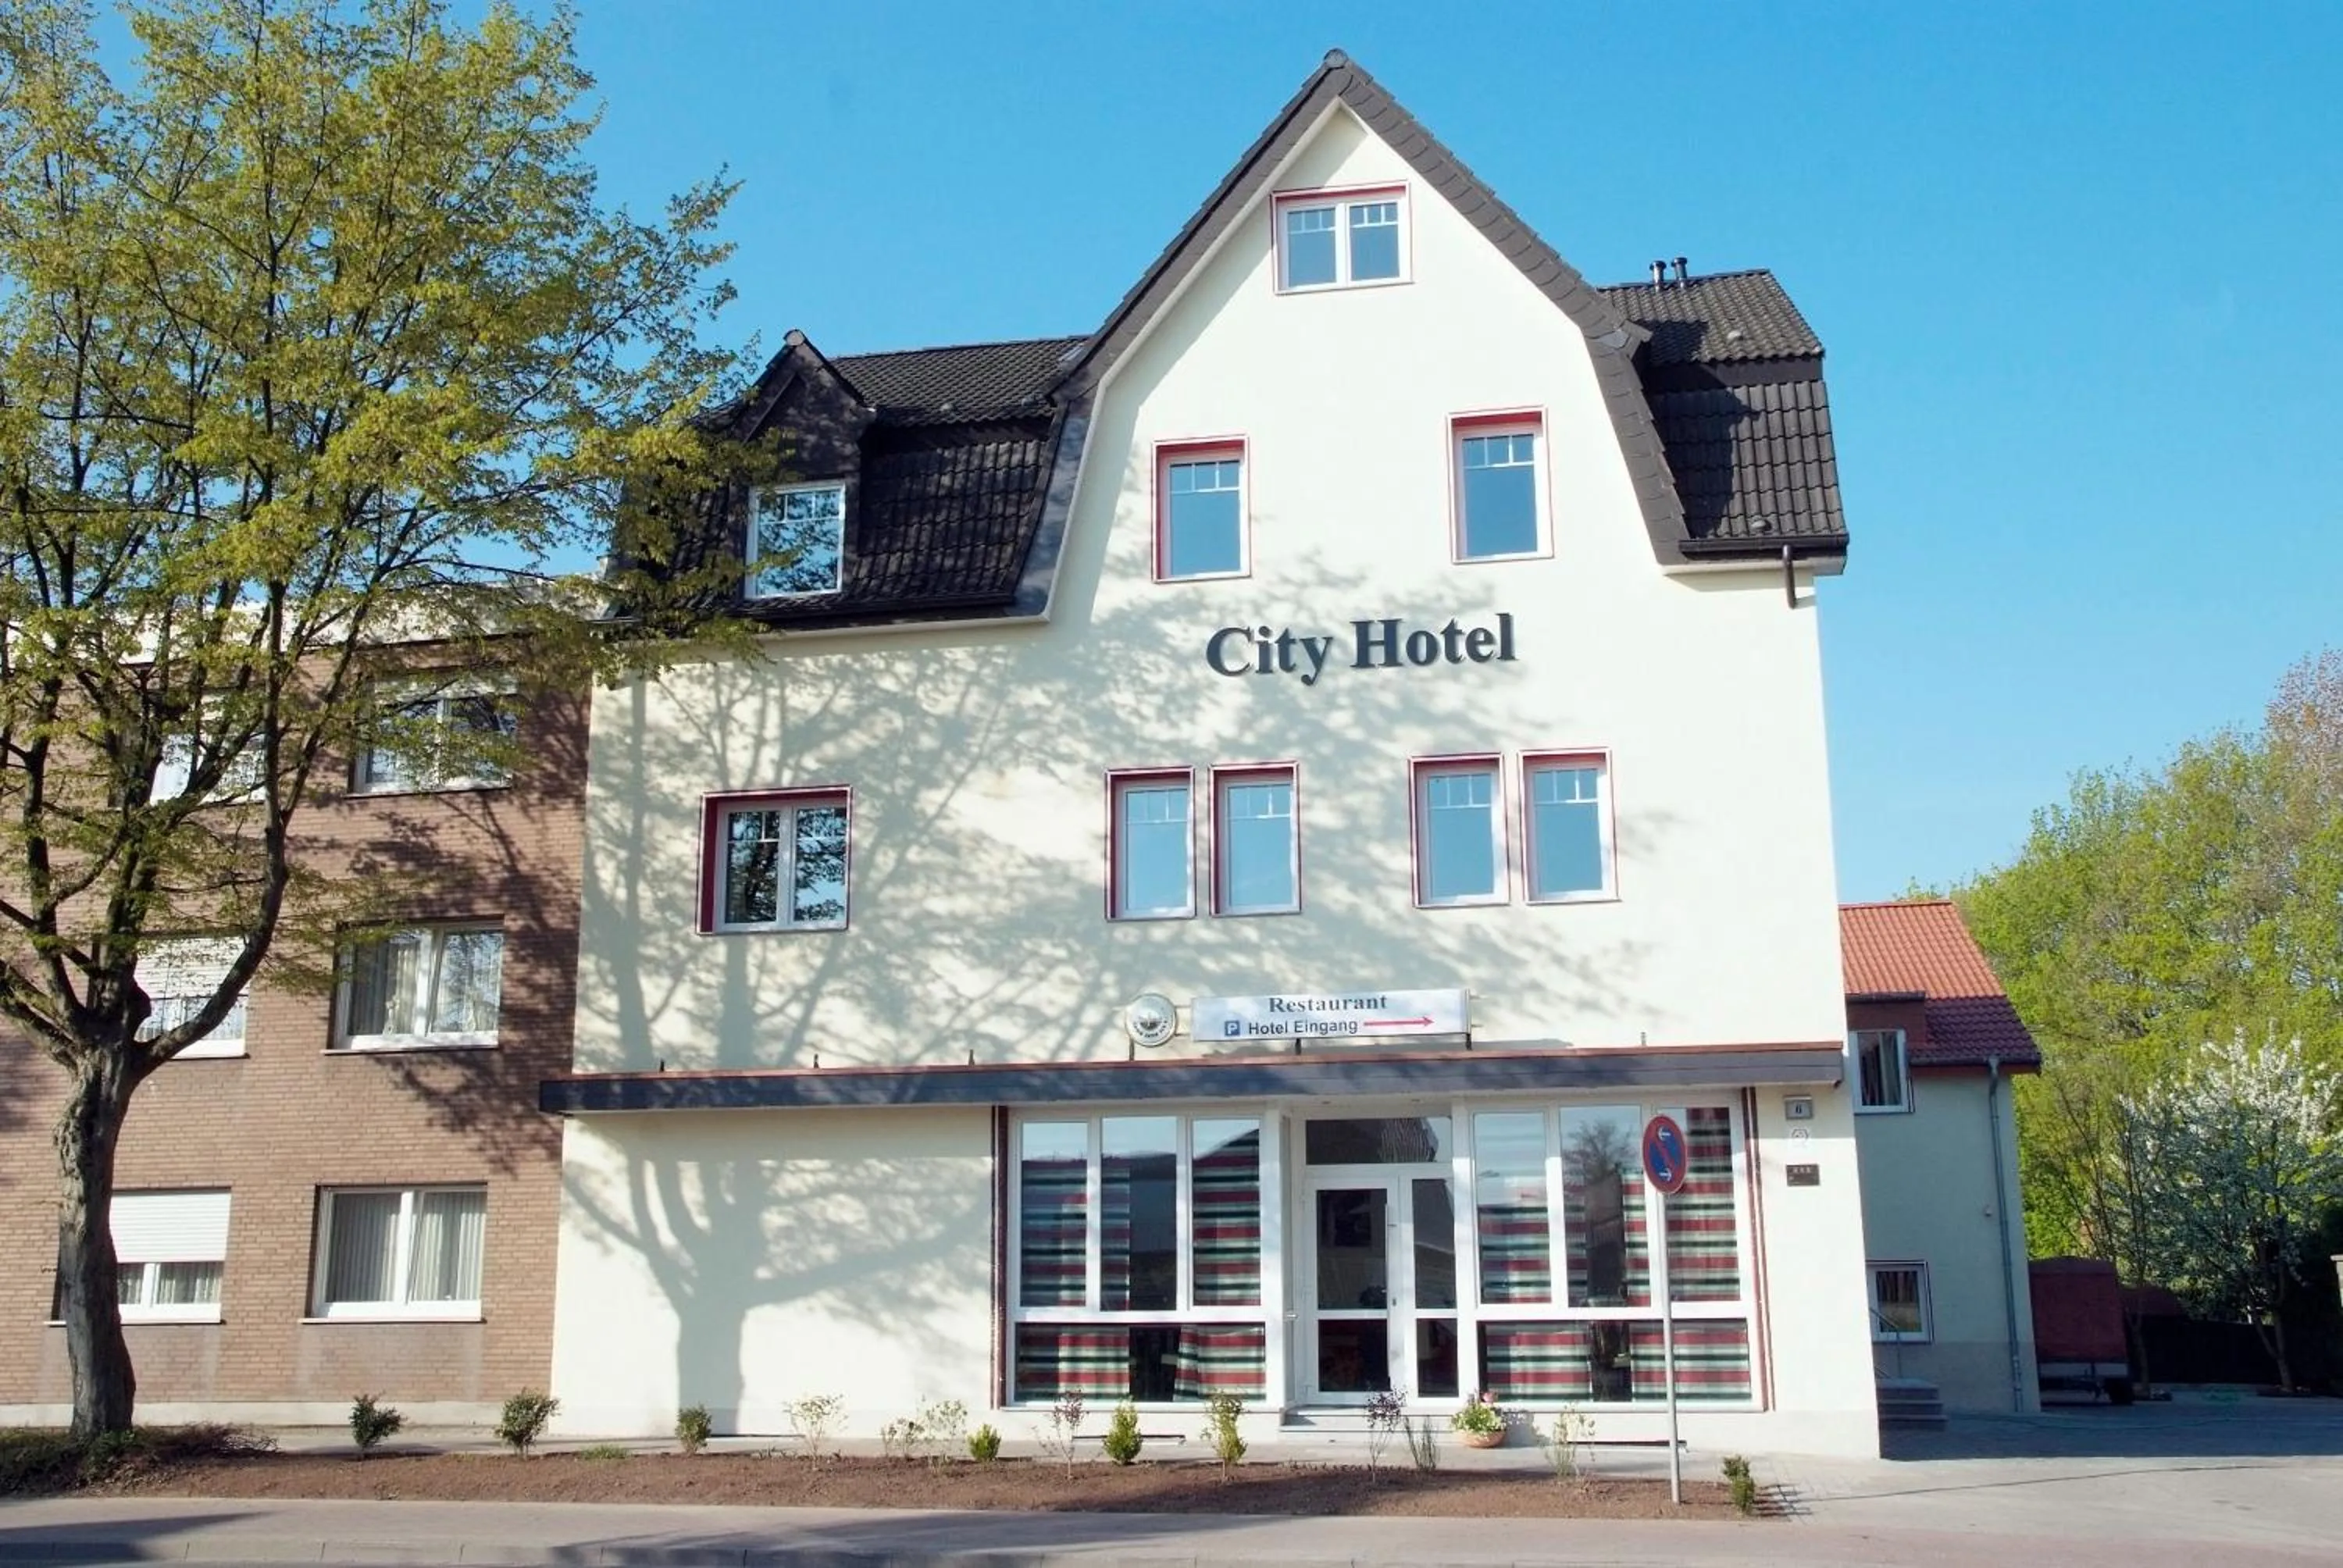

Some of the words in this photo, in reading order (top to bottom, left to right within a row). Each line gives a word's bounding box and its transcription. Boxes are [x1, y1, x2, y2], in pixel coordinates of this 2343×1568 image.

[1206, 625, 1333, 686] City
[1350, 612, 1519, 668] Hotel
[1268, 994, 1388, 1013] Restaurant
[1226, 1023, 1238, 1035] P
[1249, 1021, 1288, 1035] Hotel
[1294, 1018, 1358, 1035] Eingang
